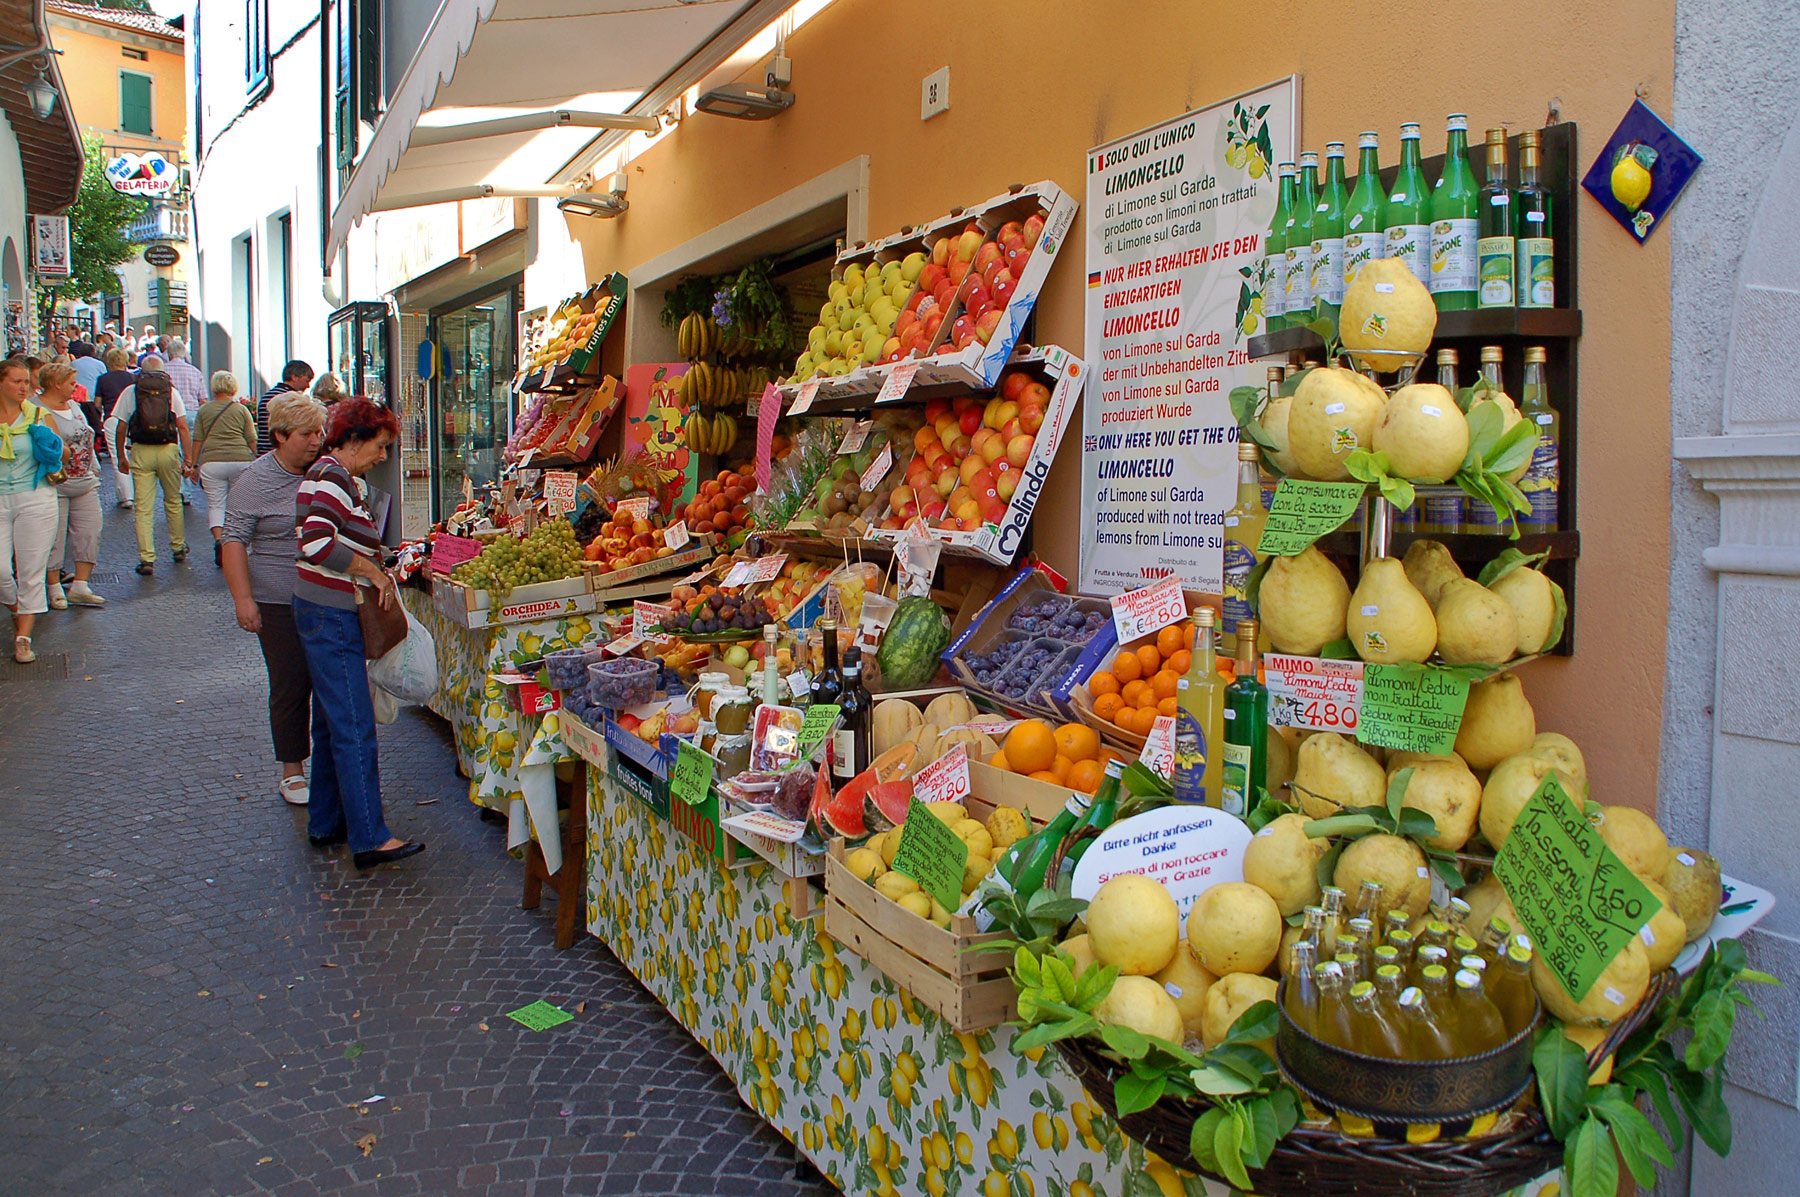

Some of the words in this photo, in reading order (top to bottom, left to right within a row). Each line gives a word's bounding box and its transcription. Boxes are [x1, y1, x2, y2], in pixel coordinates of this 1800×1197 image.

[1105, 147, 1128, 168] SOLO
[1132, 138, 1150, 159] QUI
[1154, 122, 1196, 150] L'UNICO
[115, 180, 170, 191] GELATERIA
[1105, 153, 1184, 196] LIMONCELLO
[1105, 203, 1114, 219] di
[1118, 194, 1157, 216] Limone
[1160, 186, 1177, 202] sul
[1180, 175, 1216, 198] Garda
[1104, 218, 1143, 240] prodotto
[1146, 212, 1163, 227] con
[1166, 202, 1196, 222] limoni
[1199, 196, 1219, 212] non
[1222, 183, 1257, 206] trattati
[1104, 241, 1113, 255] di
[1118, 232, 1151, 252] Limone
[1154, 226, 1169, 243] sul
[1171, 220, 1201, 239] Garda
[1434, 235, 1461, 260] LIMONE
[1104, 265, 1125, 286] NUR
[1127, 259, 1152, 280] HIER
[1155, 248, 1209, 275] ERHALTEN
[1212, 241, 1230, 261] SIE
[1234, 234, 1259, 255] DEN
[1104, 279, 1181, 309] EINZIGARTIGEN
[605, 294, 621, 320] font
[1104, 307, 1180, 339] LIMONCELLO
[585, 319, 608, 355] fruites
[1103, 348, 1122, 361] von
[1124, 340, 1163, 358] Limone
[1166, 335, 1182, 351] sul
[1186, 330, 1220, 349] Garda
[1102, 366, 1120, 382] der
[1122, 361, 1138, 378] mit
[1140, 352, 1224, 377] Unbehandelten
[1102, 390, 1120, 403] von
[1123, 382, 1163, 401] Limone
[1165, 379, 1181, 396] sul
[1185, 376, 1219, 394] Garda
[1102, 407, 1154, 427] produziert
[1156, 402, 1192, 419] Wurde
[1099, 434, 1123, 450] ONLY
[1125, 432, 1152, 449] HERE
[1155, 430, 1175, 446] YOU
[1178, 428, 1200, 445] GET
[1202, 427, 1225, 443] THE
[1098, 458, 1174, 480] LIMONCELLO
[1098, 487, 1109, 502] of
[1110, 488, 1148, 502] Limone
[1150, 487, 1167, 502] sul
[1170, 487, 1204, 502] Garda
[1280, 480, 1294, 494] Da
[998, 460, 1049, 556] Melinda
[1097, 510, 1151, 527] produced
[1154, 509, 1170, 525] with
[1173, 512, 1192, 526] not
[1096, 530, 1133, 545] lemons
[1135, 530, 1160, 546] from
[1162, 532, 1204, 548] Limone
[1116, 570, 1139, 578] Verdura
[1158, 558, 1187, 567] Distribuito
[502, 600, 561, 618] ORCHIDEA
[1118, 589, 1149, 605] MIMO
[518, 612, 547, 620] FRUTTA
[1272, 657, 1314, 673] MIMO
[1279, 708, 1292, 721] Kg
[1360, 705, 1396, 722] Cedar
[616, 764, 638, 792] fruites
[639, 780, 654, 804] font
[670, 792, 716, 854] MIMO
[744, 820, 796, 834] anfassen
[1542, 782, 1592, 859] Cedrata
[1103, 838, 1130, 852] Bitte
[1132, 830, 1160, 845] nicht
[1162, 818, 1213, 837] anfassen
[1142, 841, 1177, 857] Danke
[1148, 862, 1158, 873] di
[1161, 856, 1182, 870] non
[1185, 847, 1228, 864] toccare
[1526, 808, 1583, 896] Tassoni
[1173, 865, 1212, 882] Grazie
